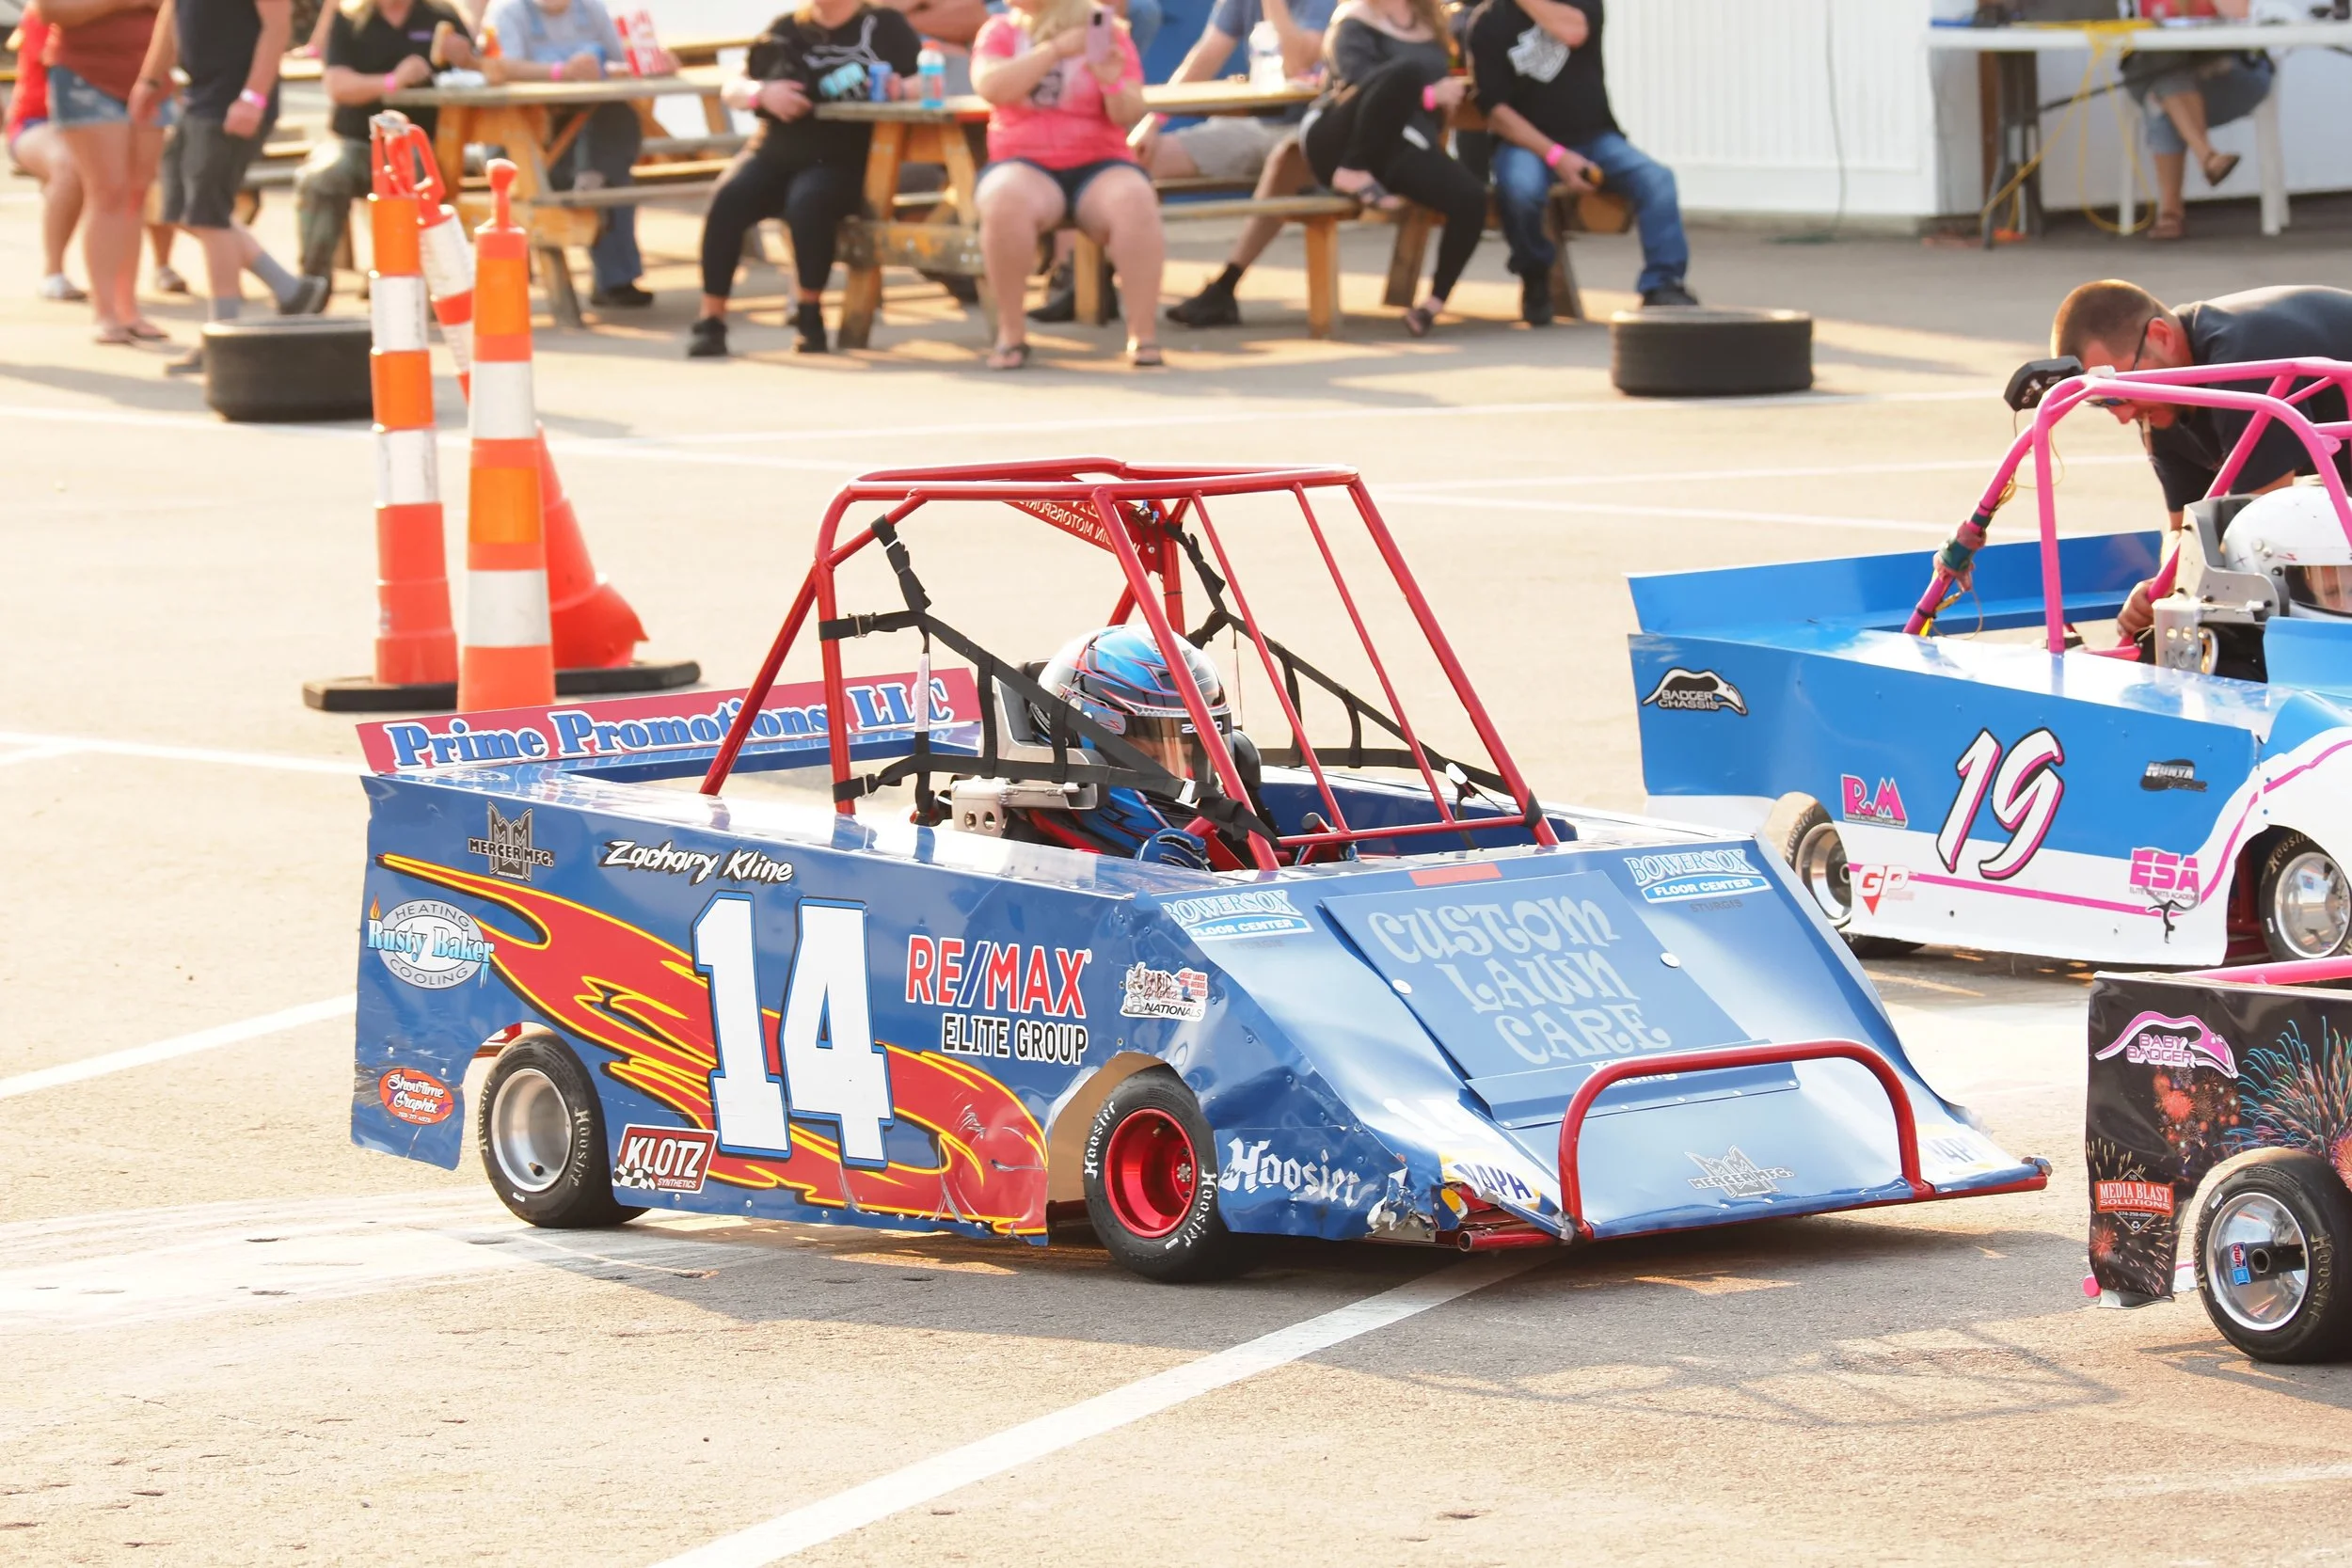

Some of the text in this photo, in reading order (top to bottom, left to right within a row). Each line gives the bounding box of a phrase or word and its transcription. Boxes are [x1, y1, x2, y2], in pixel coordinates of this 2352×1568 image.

[1659, 700, 1720, 710] CHASSIS
[1661, 689, 1713, 701] BADGER
[382, 718, 549, 769] Prime
[846, 677, 954, 730] LLC
[1937, 726, 2064, 879] 19
[468, 838, 523, 862] MERCER
[599, 840, 793, 886] Zachary Kline
[1623, 848, 1762, 886] BOWERSOX
[2130, 849, 2200, 893] ESA
[1654, 878, 1753, 896] FLOOR CENTER
[395, 904, 470, 927] HEATING
[1689, 898, 1744, 912] STURGIS
[1189, 919, 1295, 937] FLOOR CENTER
[1368, 895, 1621, 964] CUSTOM
[367, 919, 496, 964] Rusty Baker
[389, 958, 469, 986] COOLING
[1433, 945, 1642, 1015] LAWN
[1144, 1003, 1202, 1018] NATIONALS
[692, 889, 896, 1169] 14
[942, 1013, 1089, 1066] ELITE GROUP
[1494, 1003, 1673, 1066] CARE
[2138, 1033, 2187, 1050] BABY
[2127, 1045, 2195, 1067] BADGER
[624, 1135, 707, 1179] KLOTZ
[657, 1177, 697, 1189] SYNTHETICS
[1218, 1136, 1361, 1208] Hoosier
[1688, 1171, 1756, 1190] MERCER
[2099, 1182, 2169, 1203] MEDIA BLAST
[2100, 1198, 2170, 1210] SOLUTIONS
